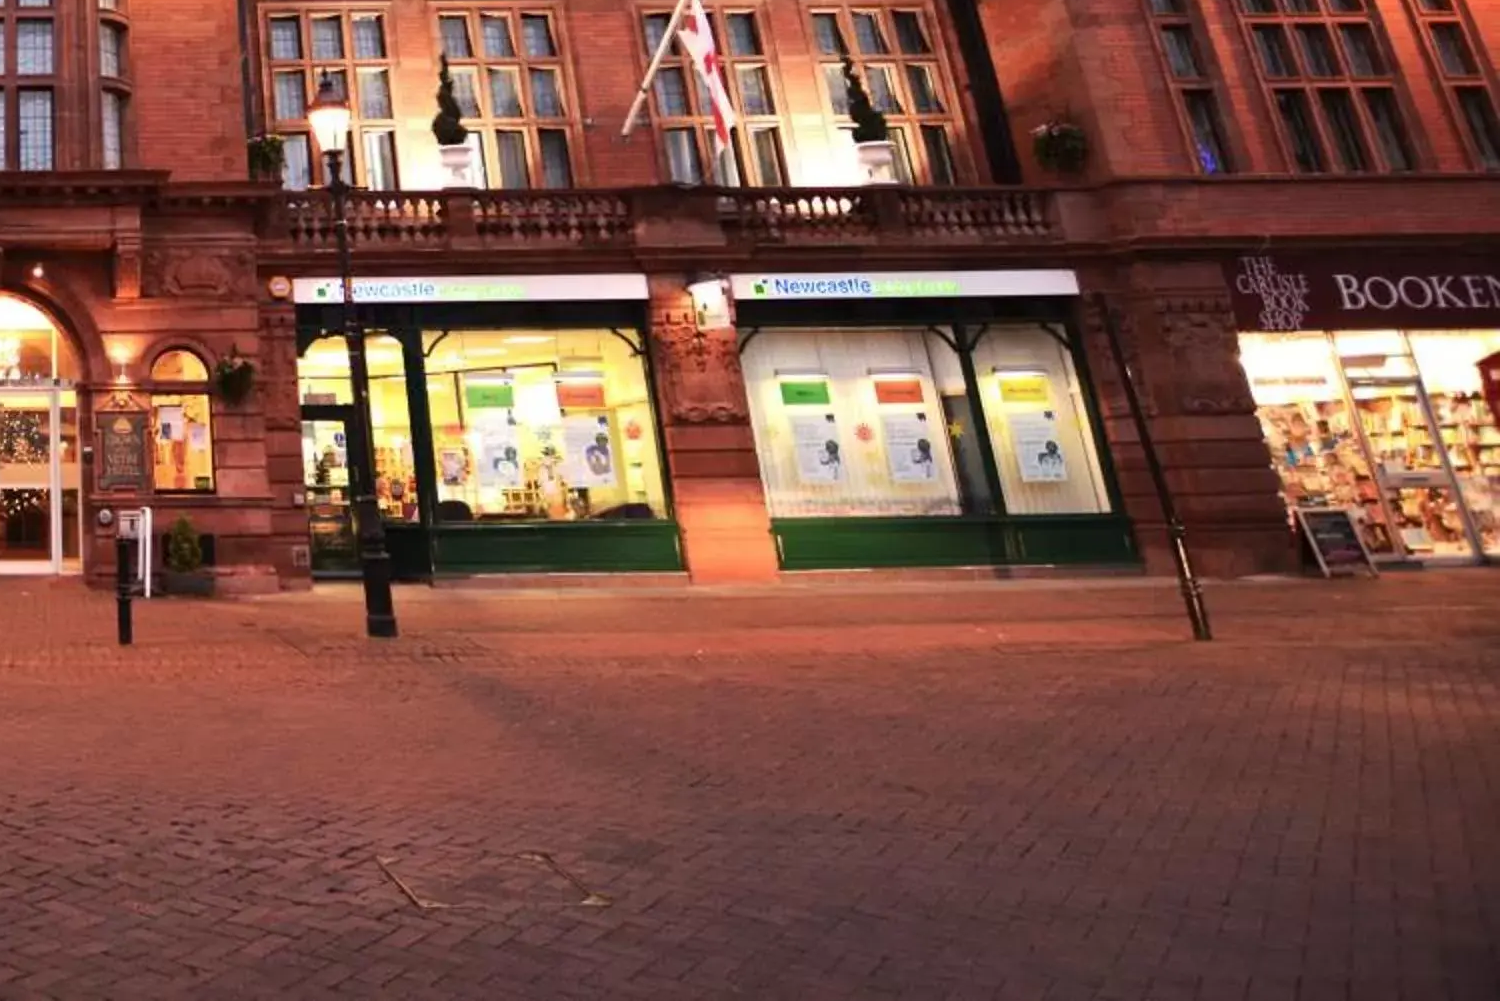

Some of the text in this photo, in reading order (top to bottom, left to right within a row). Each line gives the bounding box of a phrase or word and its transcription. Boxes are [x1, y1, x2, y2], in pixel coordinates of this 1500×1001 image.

[1240, 256, 1276, 276] THE
[774, 278, 872, 295] Newcastle
[1236, 274, 1310, 294] CARLISLE
[1262, 293, 1310, 312] BOOK
[1260, 310, 1303, 330] SHOP
